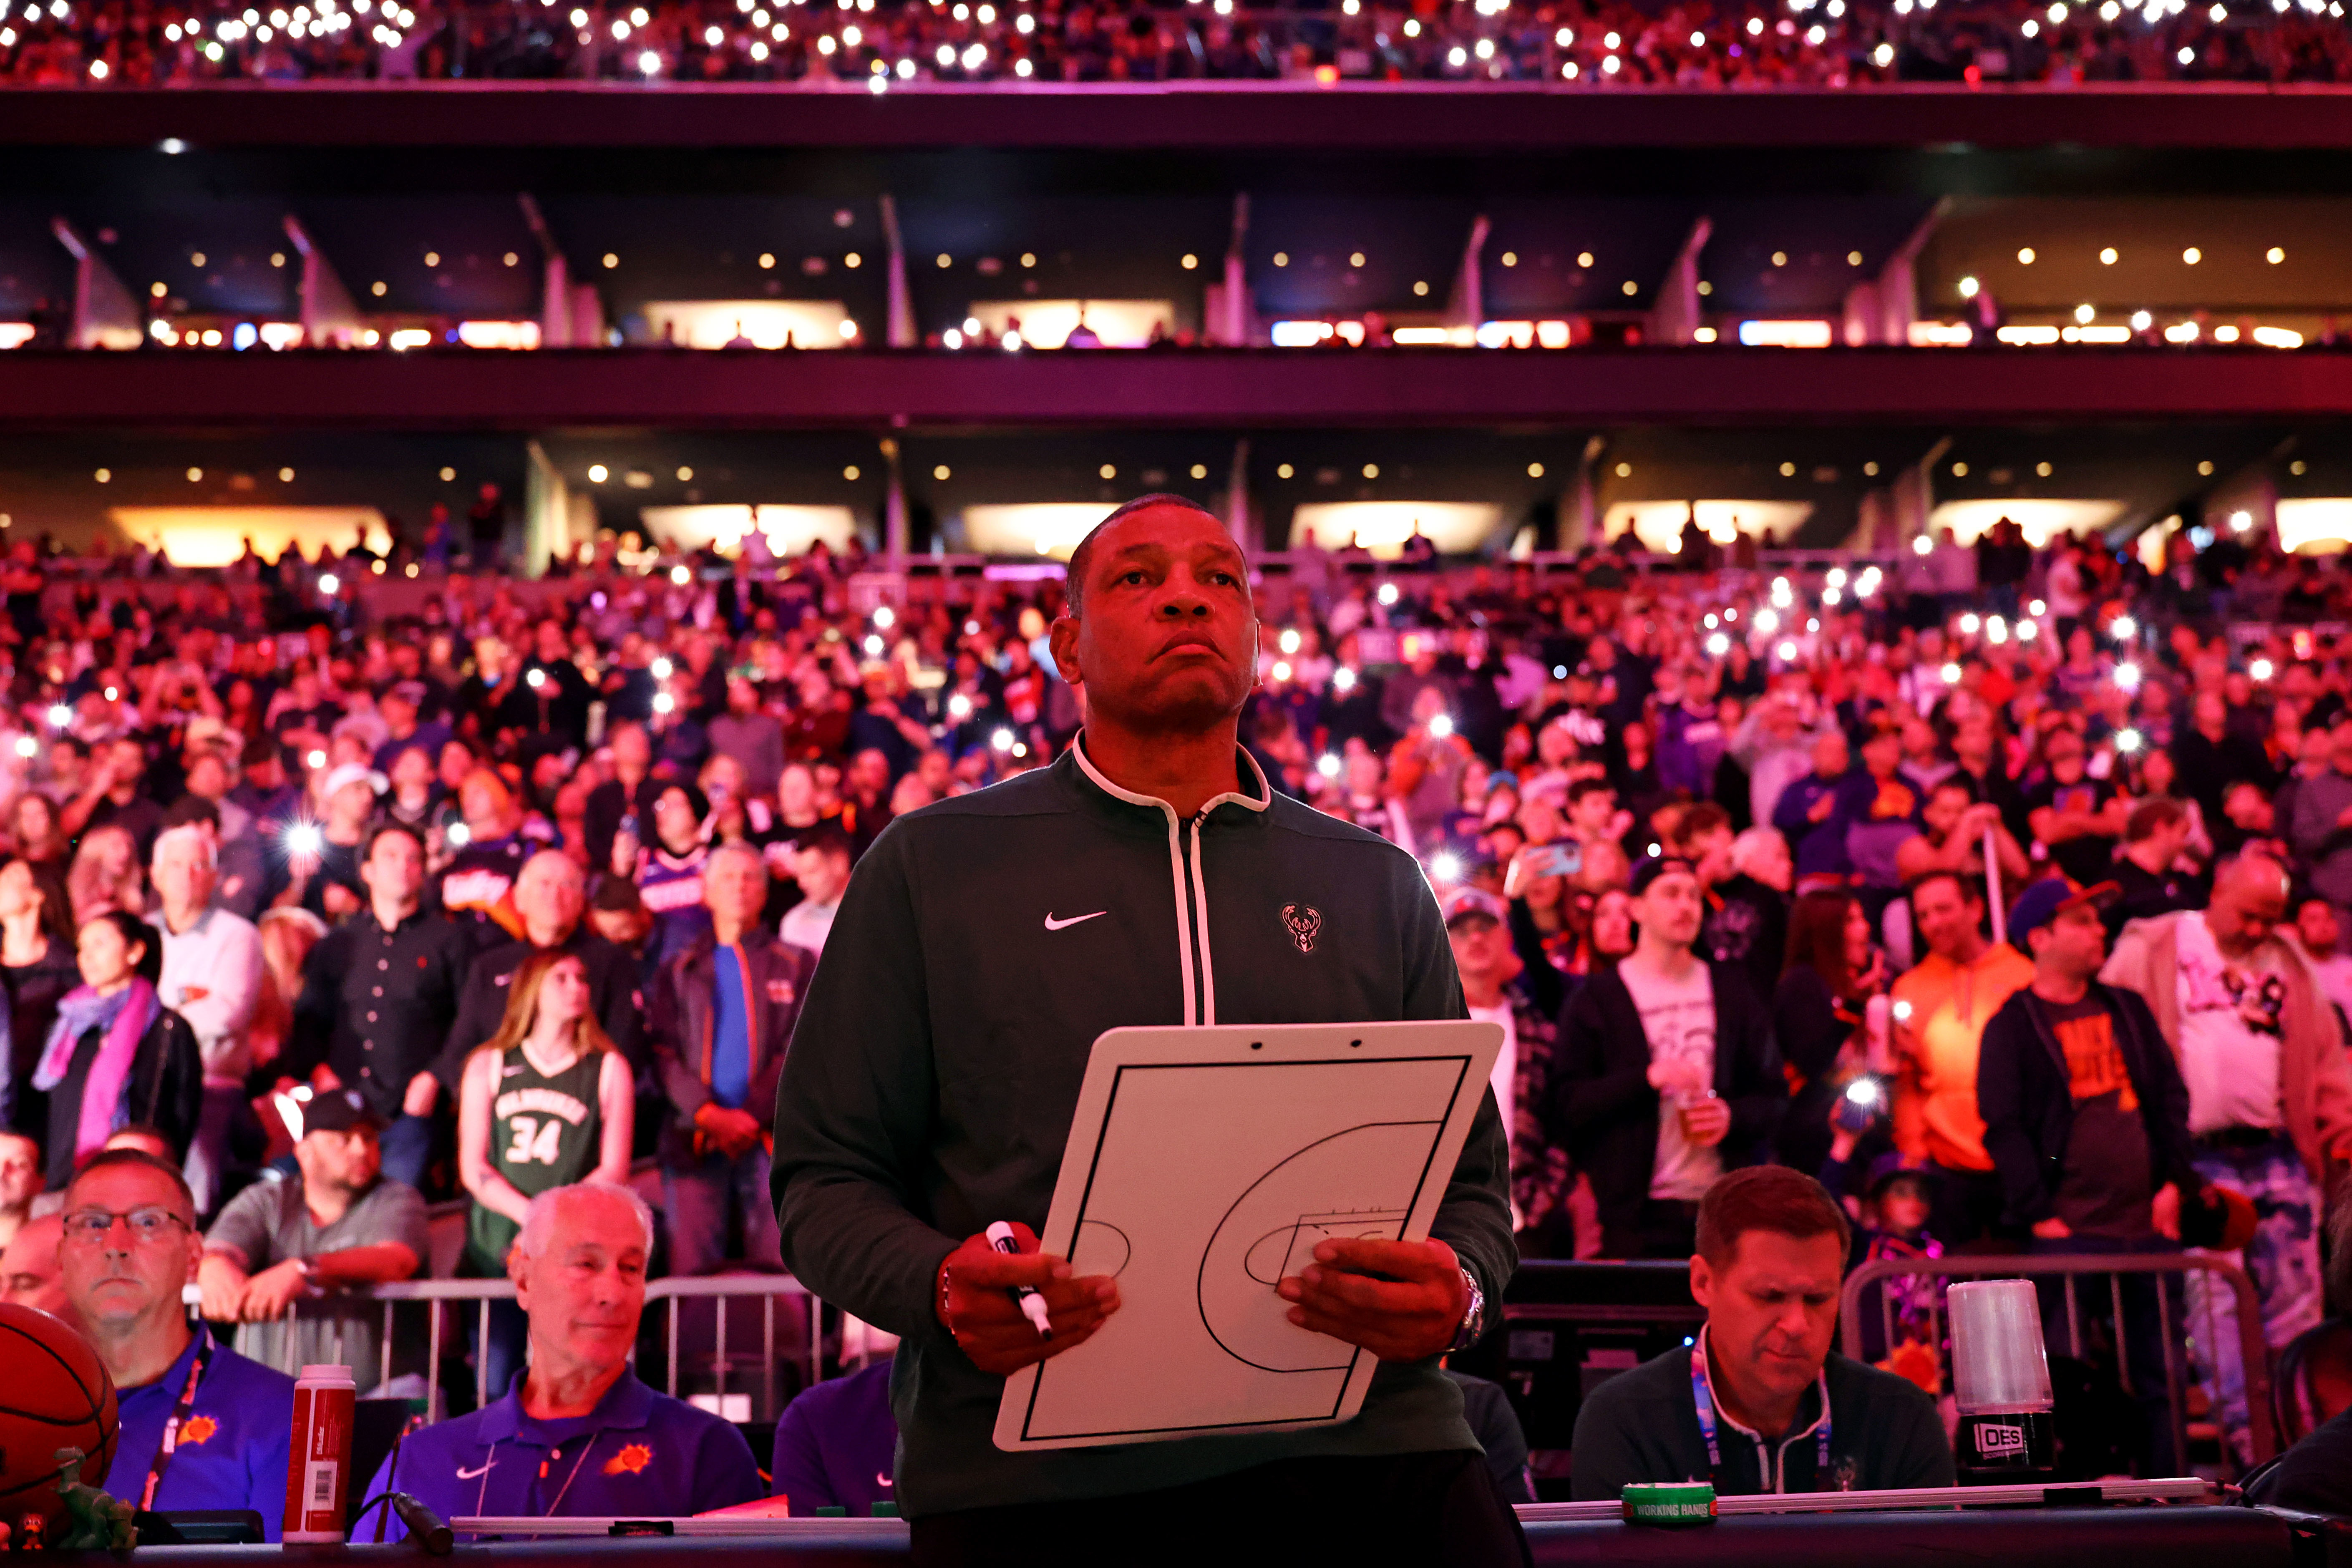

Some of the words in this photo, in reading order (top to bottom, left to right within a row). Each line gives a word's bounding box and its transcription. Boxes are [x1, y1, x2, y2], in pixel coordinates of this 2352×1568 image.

[506, 1116, 562, 1165] 34
[1986, 1429, 2020, 1446] OES
[1637, 1504, 1679, 1516] WORKING
[1681, 1503, 1707, 1515] HANDS
